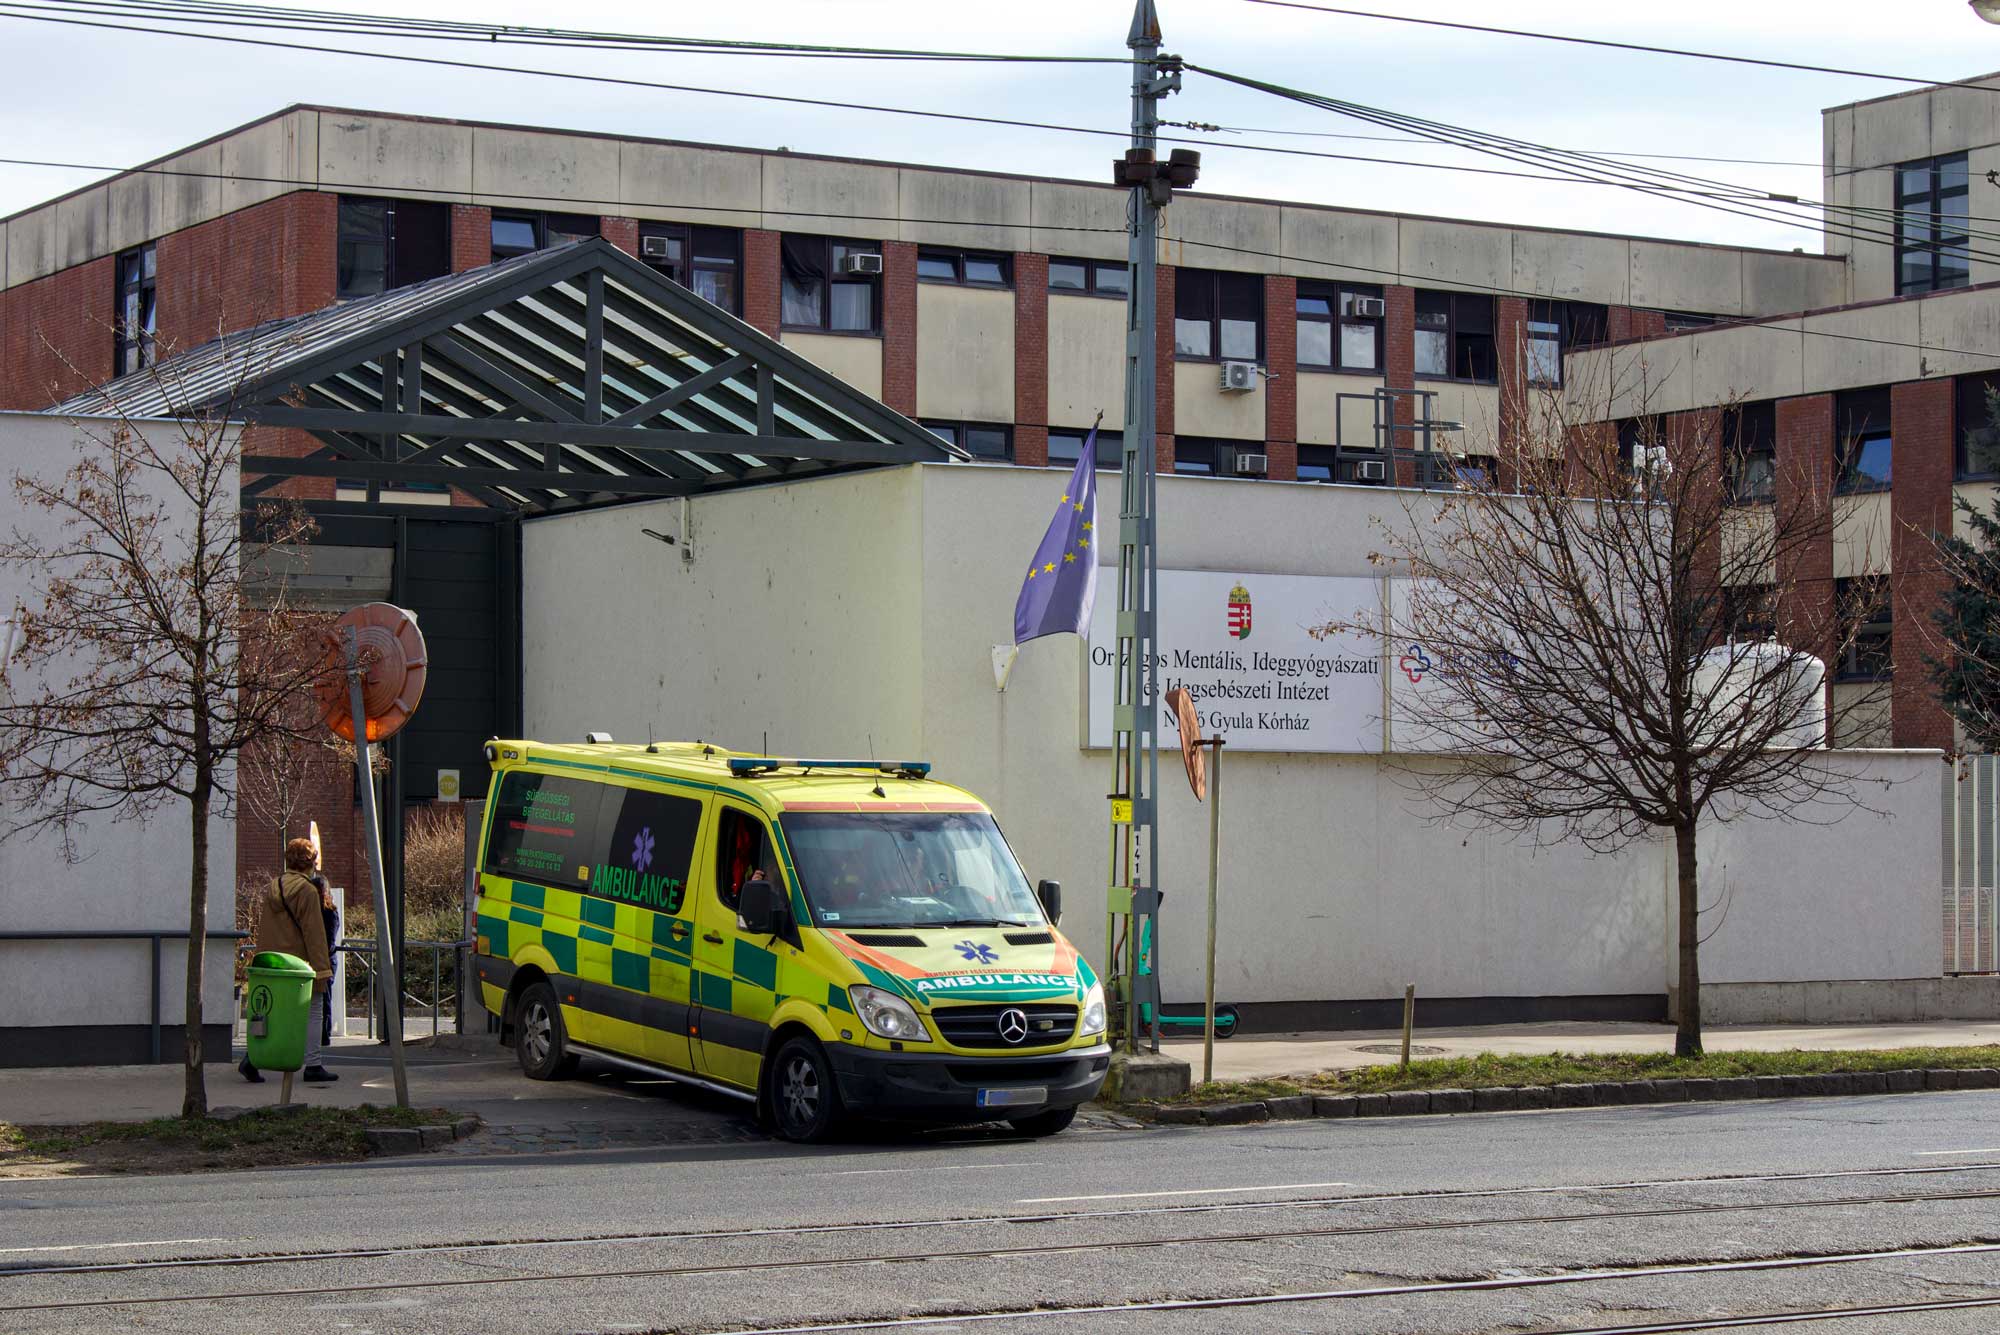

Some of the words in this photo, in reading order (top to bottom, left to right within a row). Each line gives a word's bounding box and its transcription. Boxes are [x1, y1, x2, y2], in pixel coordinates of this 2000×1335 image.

[1092, 646, 1167, 673] Orzgs
[1174, 649, 1247, 673] Mentális,
[1253, 651, 1378, 677] Ideggyógyászati
[1277, 680, 1330, 700] Intézet
[1210, 711, 1252, 733] Gyula
[1258, 711, 1310, 731] Kórház
[440, 781, 457, 790] STOP
[591, 863, 680, 910] AMBULANCE
[916, 974, 1081, 992] AMBULANCE
